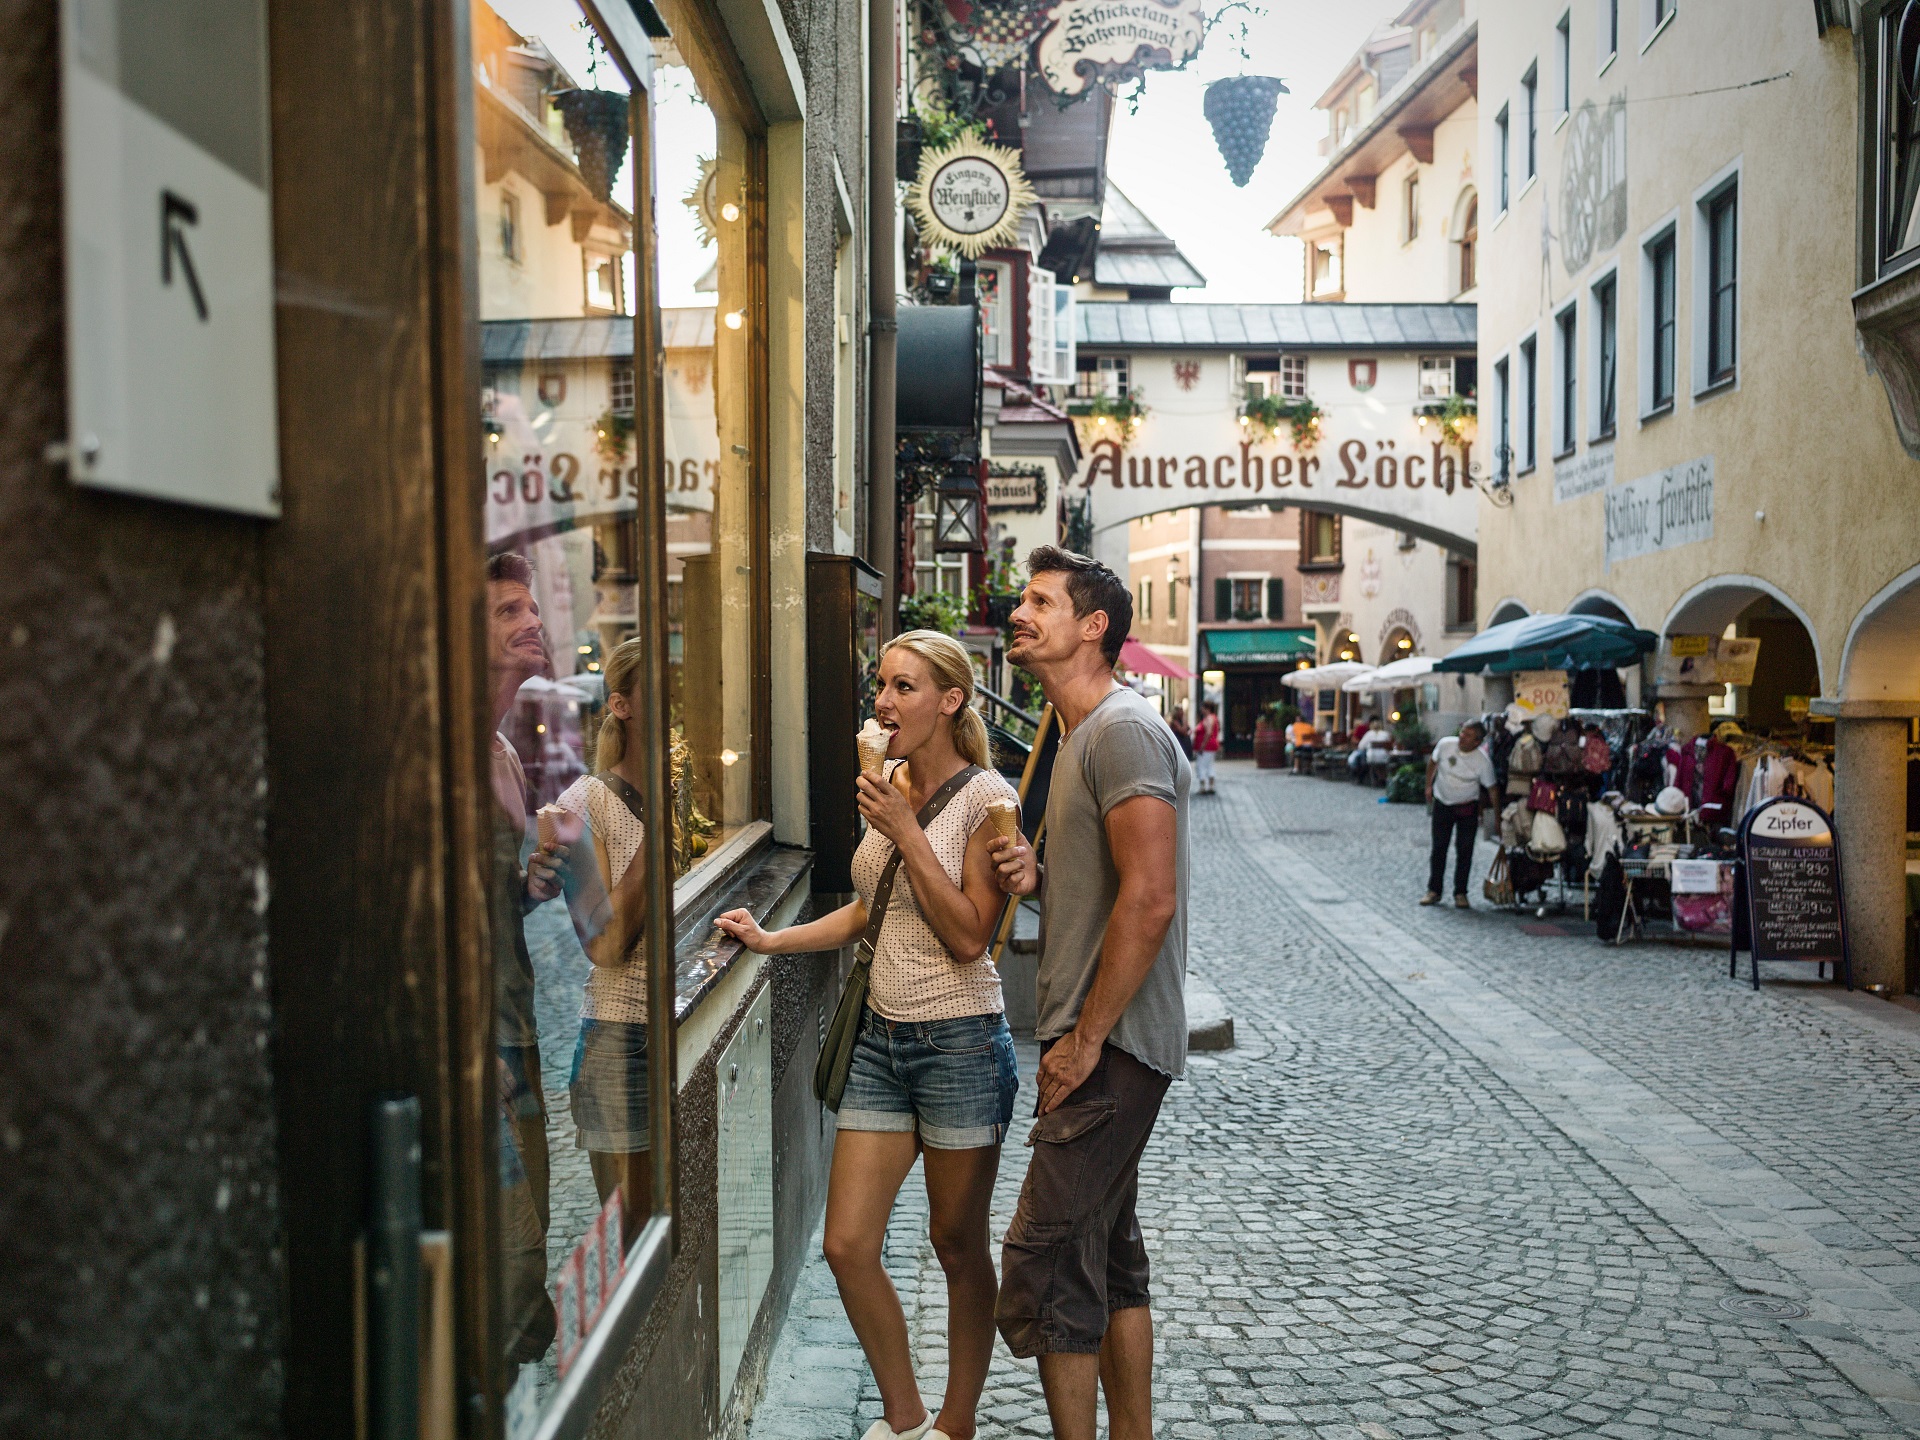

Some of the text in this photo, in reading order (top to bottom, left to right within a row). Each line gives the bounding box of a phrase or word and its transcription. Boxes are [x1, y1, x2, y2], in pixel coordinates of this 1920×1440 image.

[1067, 3, 1179, 31] Schicketanz
[944, 170, 992, 187] Eingang
[1080, 439, 1475, 496] Auracher Löchl
[1767, 816, 1813, 834] Zipfer
